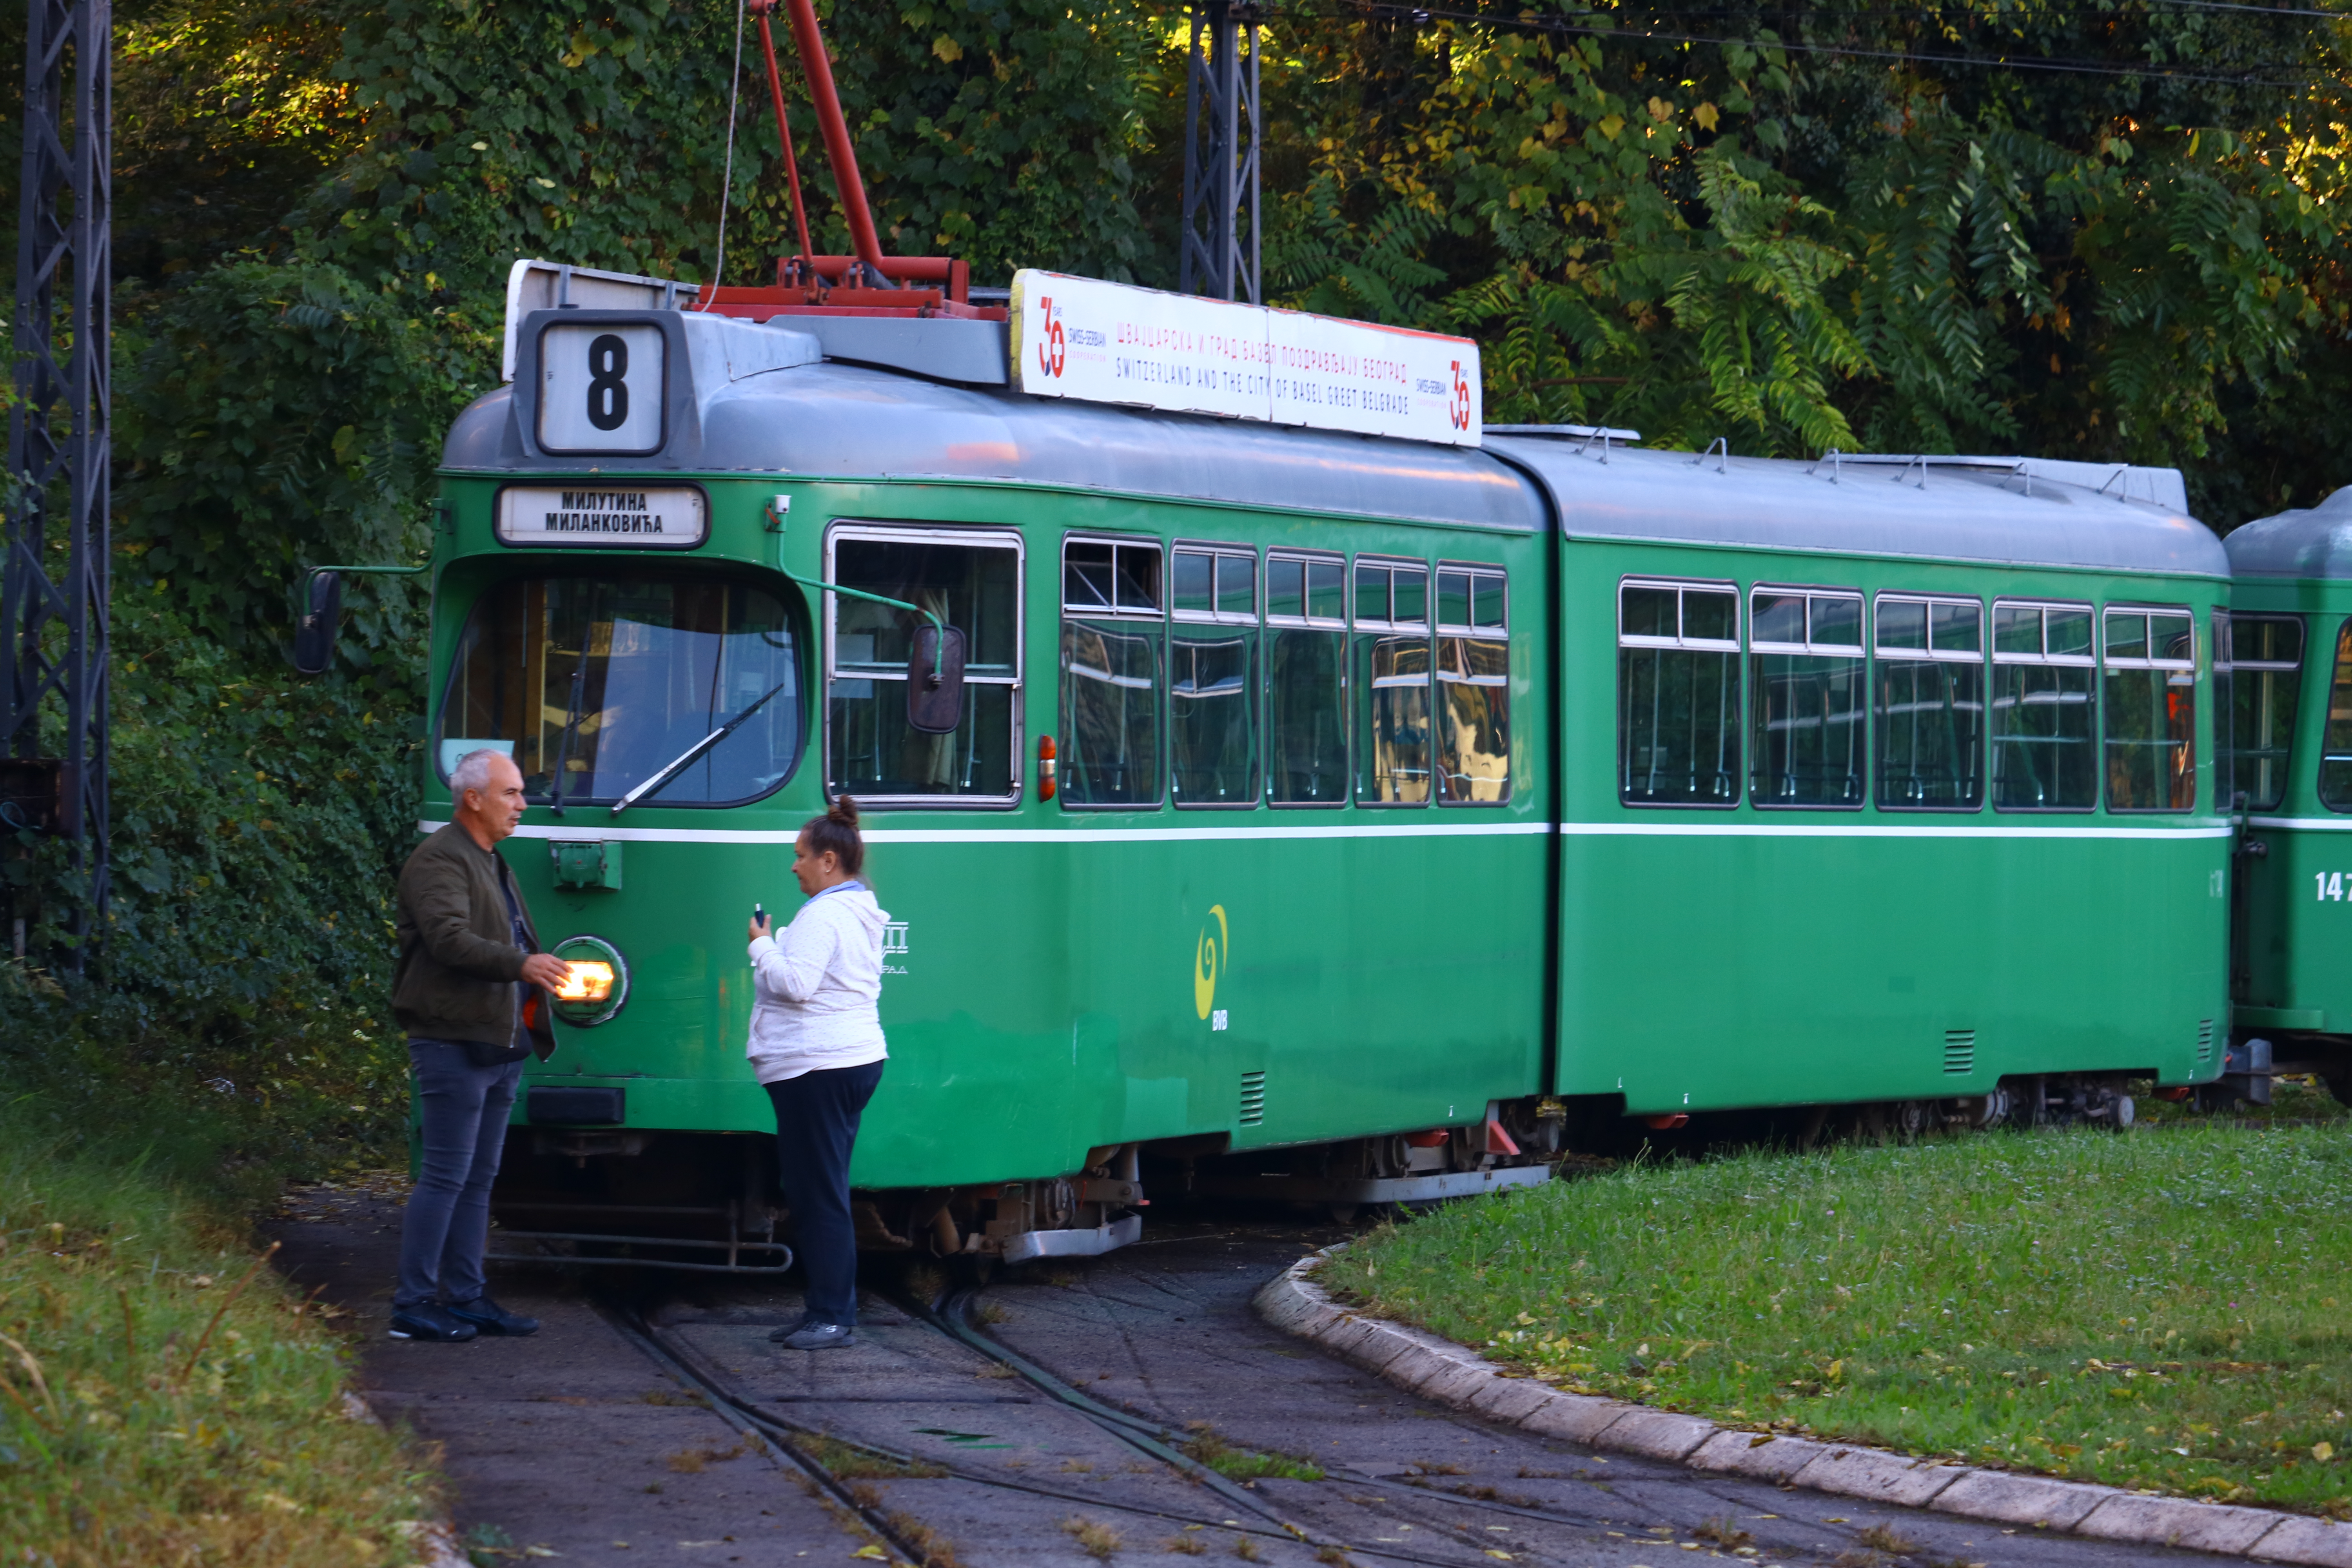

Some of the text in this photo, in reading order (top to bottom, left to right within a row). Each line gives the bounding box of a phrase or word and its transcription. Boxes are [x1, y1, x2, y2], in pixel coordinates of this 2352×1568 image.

[1069, 328, 1107, 347] SWISS-SERBIAN
[1069, 350, 1106, 362] COOPERATION
[1117, 321, 1406, 386] ШВАЈЦАРСКА И ГРАД БАЗЕЛ ПОЗДРАВЉАЈУ БЕОГРАД
[587, 334, 628, 431] 8
[1117, 357, 1408, 415] SWITZERLAND AND THE CITY OF BASEL GREET BELGRADE
[561, 492, 647, 510] МИЛУТИНА
[545, 513, 663, 533] МИЛАНКОВИЋА
[1212, 1009, 1228, 1031] BVB
